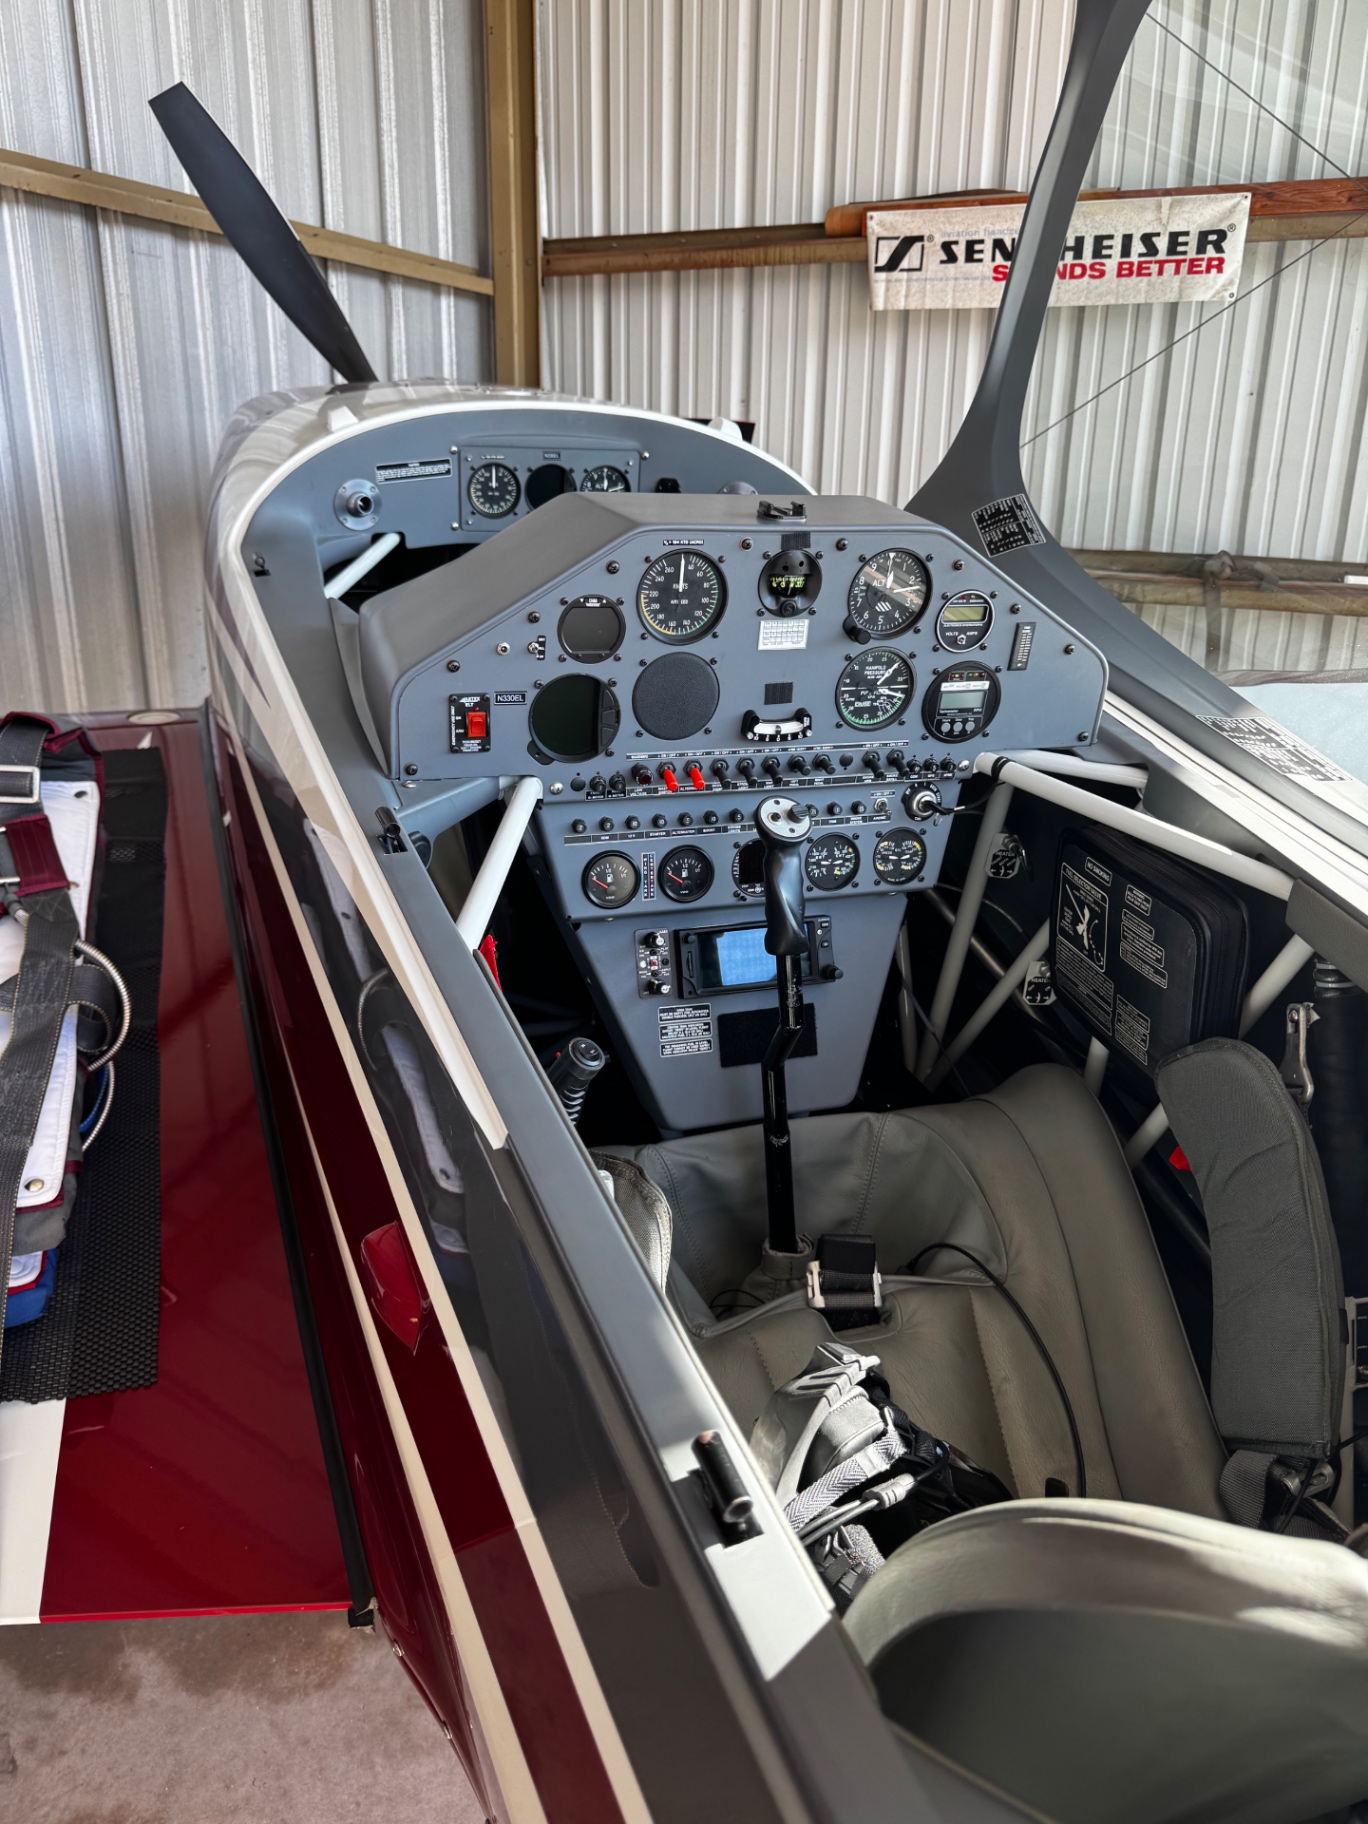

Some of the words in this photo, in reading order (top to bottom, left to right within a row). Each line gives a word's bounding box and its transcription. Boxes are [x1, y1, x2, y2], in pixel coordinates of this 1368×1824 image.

[940, 229, 980, 238] aviation
[983, 227, 1019, 236] headse
[939, 229, 1228, 264] SENHEISER
[992, 261, 1106, 282] SNDS
[1116, 256, 1226, 279] BETTER
[872, 563, 877, 571] 9
[903, 563, 906, 571] 1
[859, 577, 864, 585] 8
[909, 576, 915, 584] 2
[857, 599, 862, 607] 7
[905, 598, 910, 606] 3
[864, 611, 869, 619] 6
[895, 610, 899, 618] 4
[878, 616, 883, 624] 5
[1093, 866, 1110, 881] SMOKING
[1073, 874, 1090, 890] SELECTOR
[1090, 888, 1102, 900] VALVE
